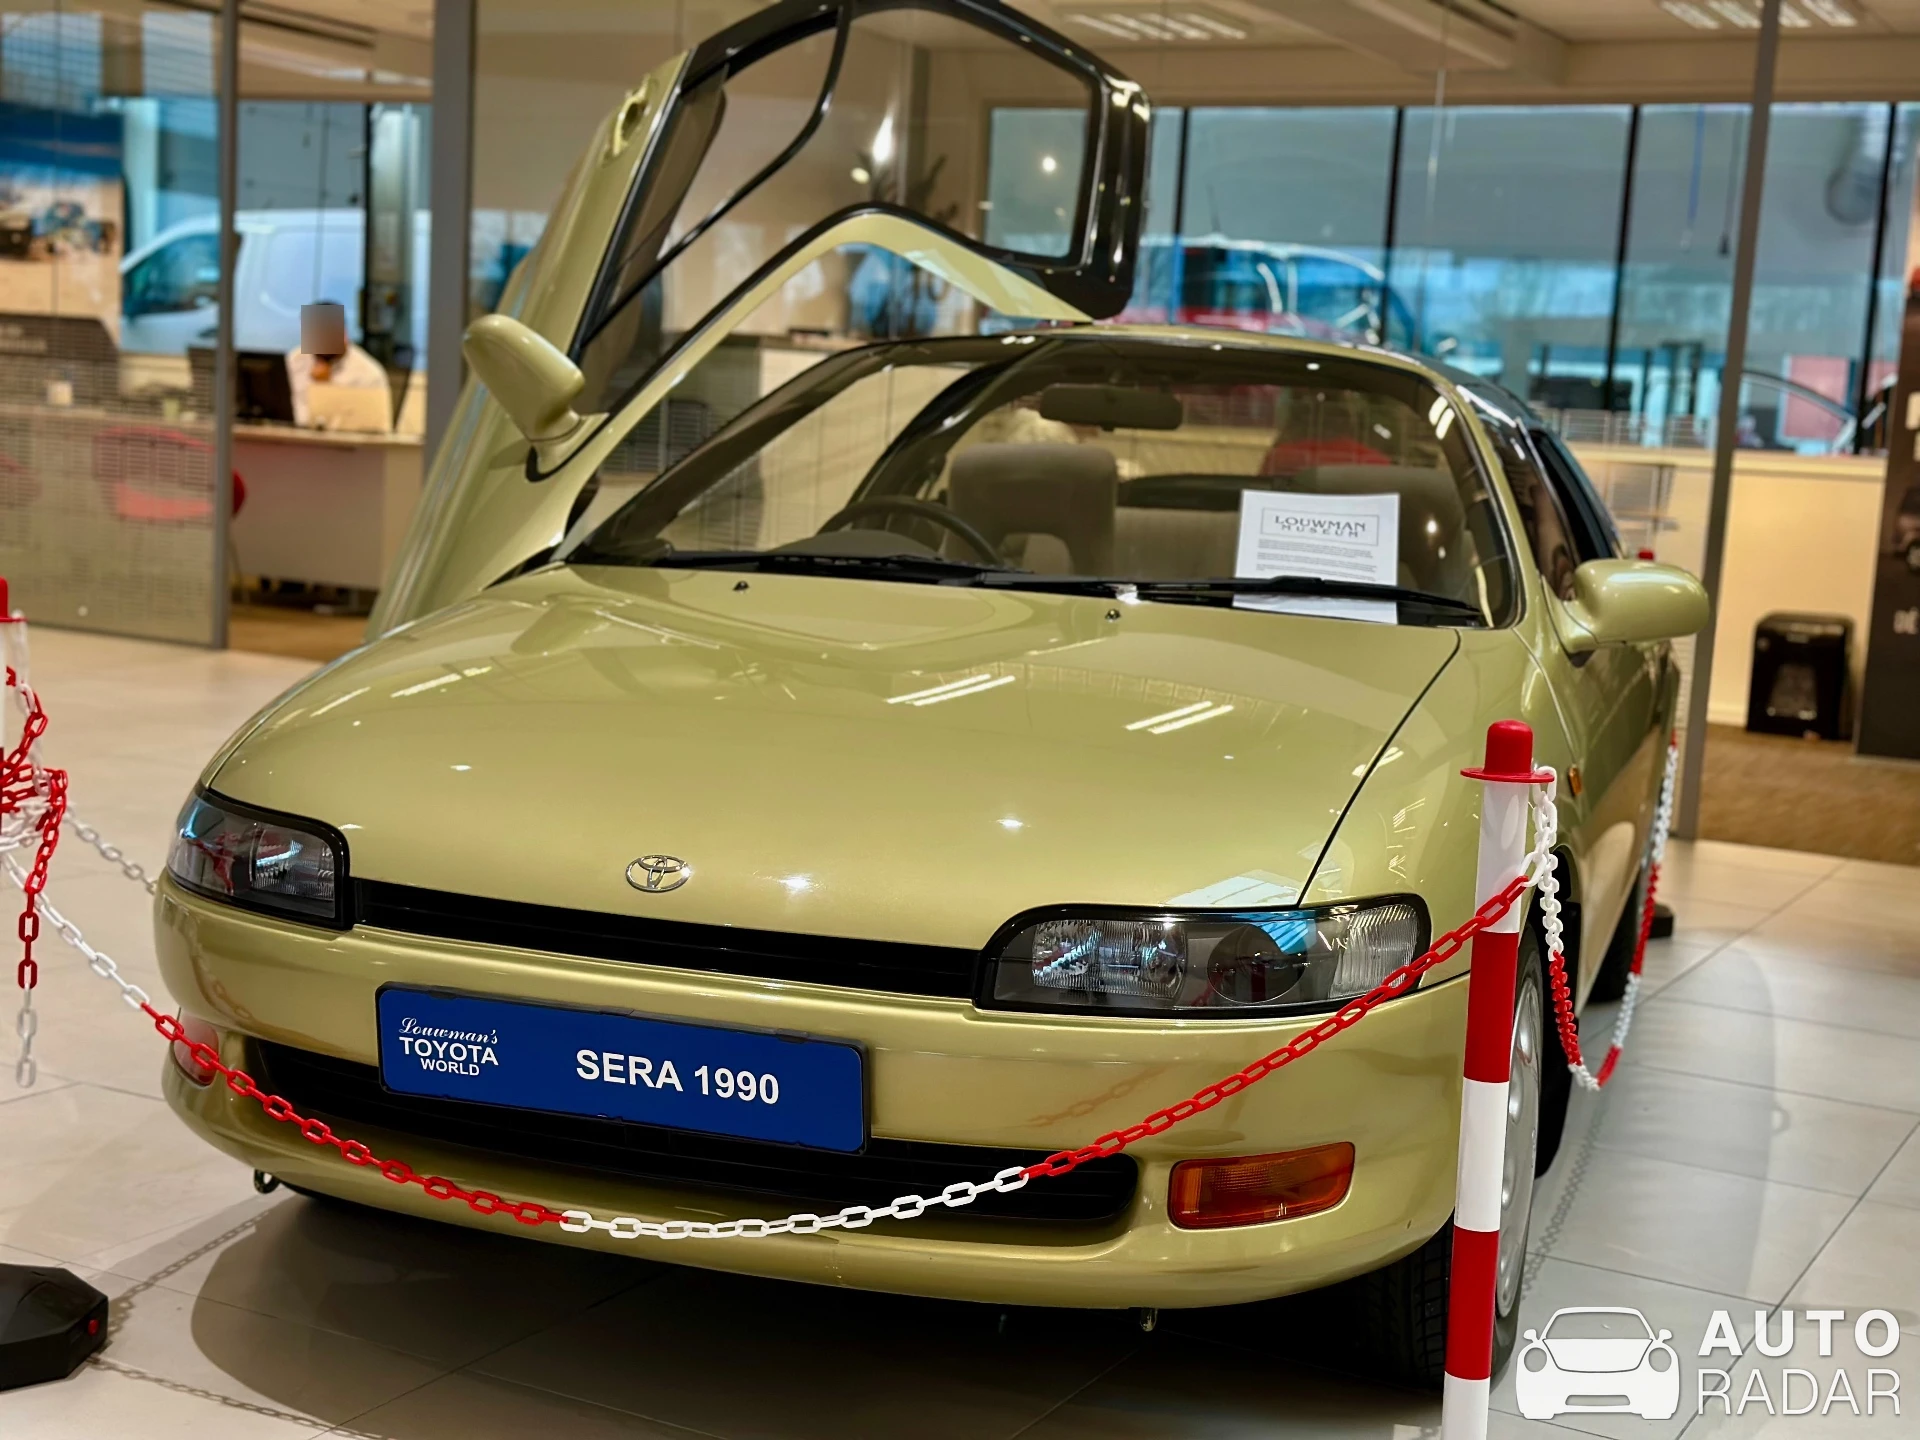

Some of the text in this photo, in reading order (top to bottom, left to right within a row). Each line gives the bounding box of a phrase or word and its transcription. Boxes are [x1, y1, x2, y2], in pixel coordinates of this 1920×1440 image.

[1275, 515, 1366, 532] LOUWMAN
[1281, 524, 1359, 538] MUSEUM
[399, 1017, 498, 1044] Louwman's
[399, 1036, 499, 1066] TOYOTA
[420, 1057, 480, 1076] WORLD
[576, 1049, 779, 1105] SERA 1990
